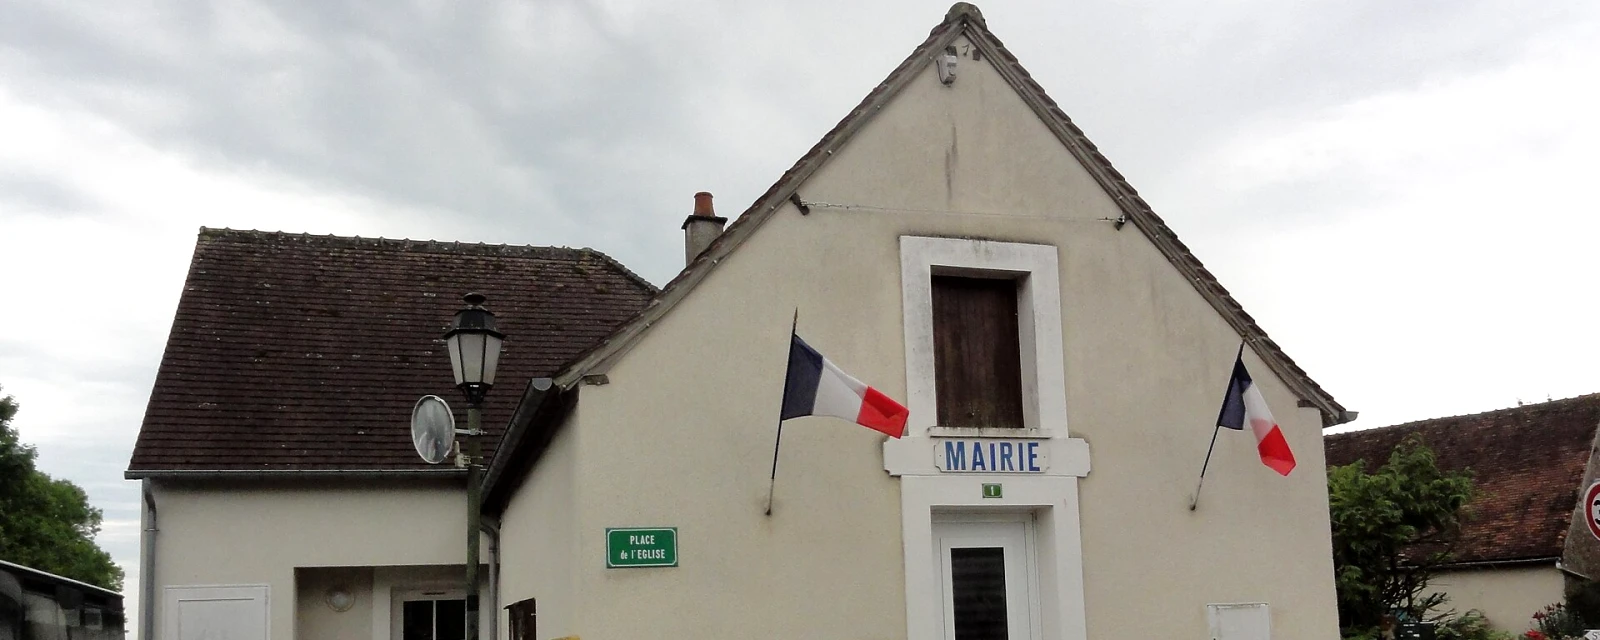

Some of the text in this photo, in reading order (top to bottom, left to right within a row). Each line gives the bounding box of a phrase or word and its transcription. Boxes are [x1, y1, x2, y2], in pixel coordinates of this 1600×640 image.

[945, 441, 1040, 471] MAIRIE
[989, 485, 995, 496] 1
[630, 535, 655, 545] PLACE
[620, 549, 665, 560] de l'EGLISE
